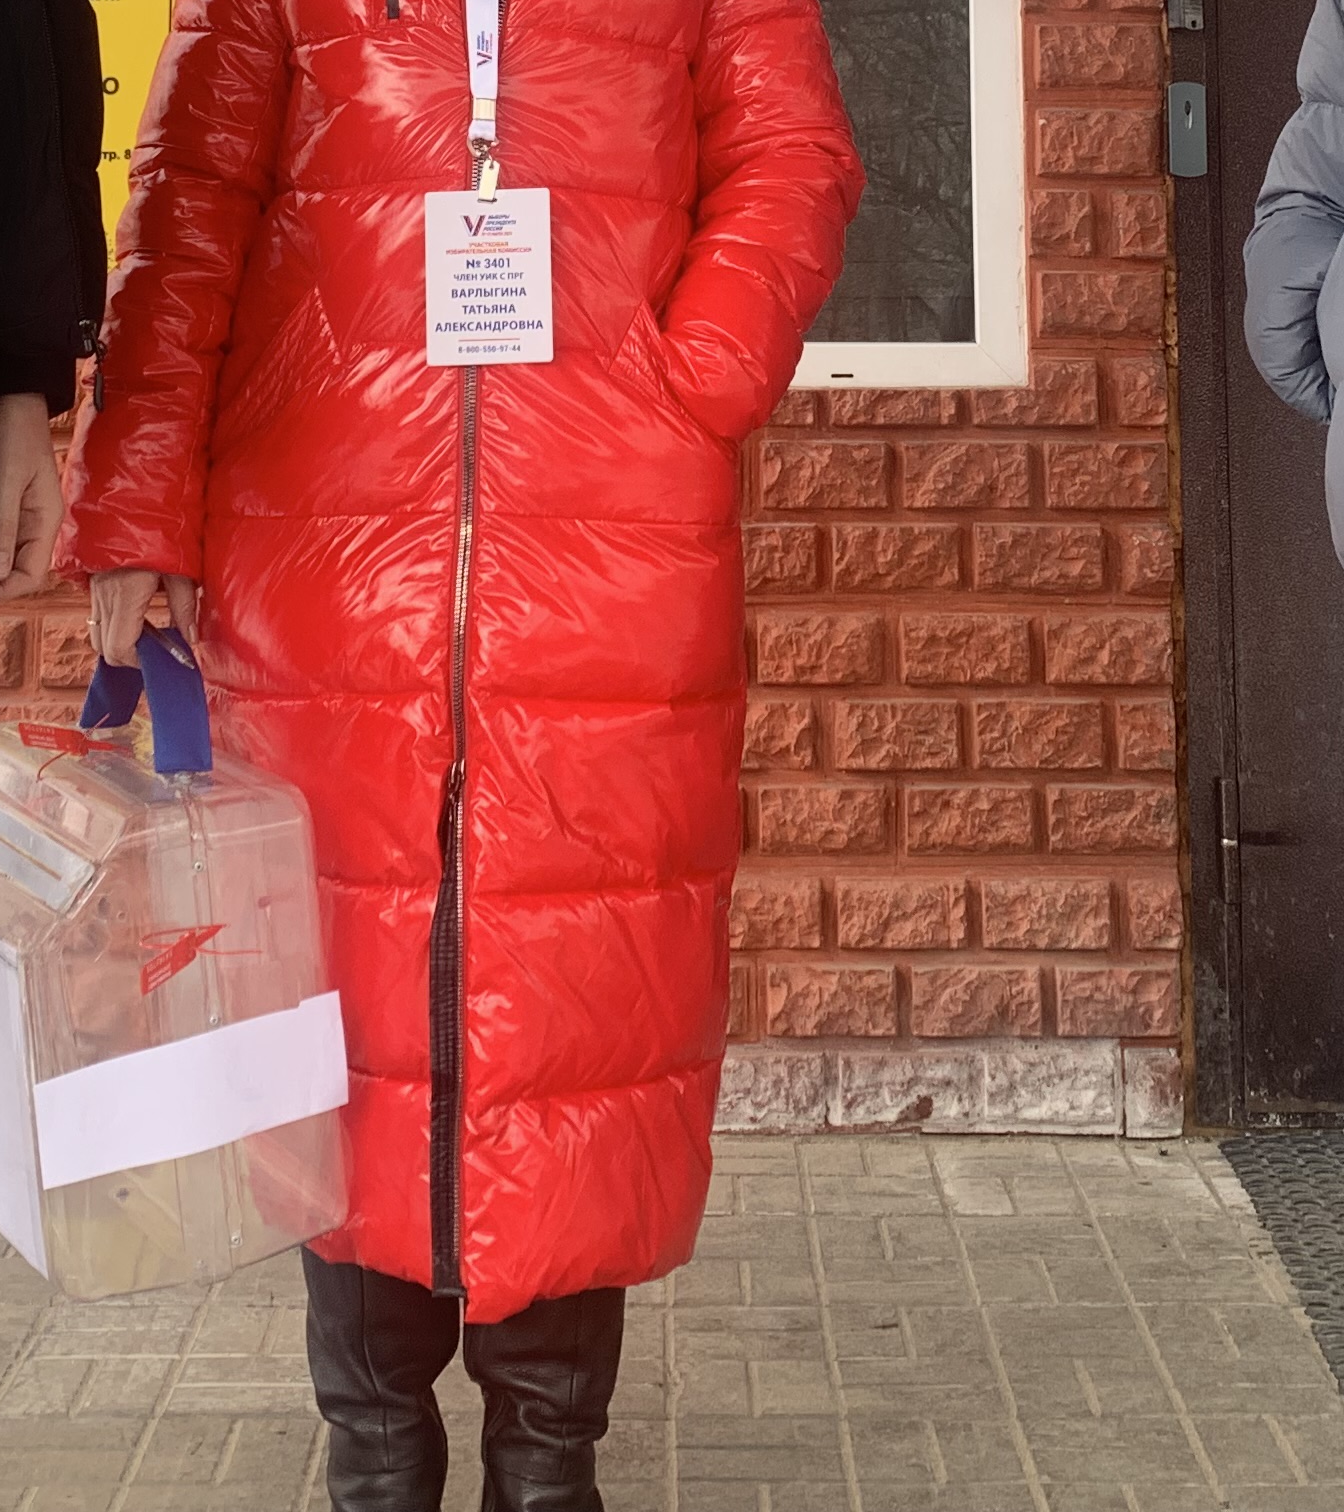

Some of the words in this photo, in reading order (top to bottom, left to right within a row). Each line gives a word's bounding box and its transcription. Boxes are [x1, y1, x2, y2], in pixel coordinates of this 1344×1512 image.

[484, 258, 510, 269] 3401
[453, 273, 478, 281] ЧЛЕН
[480, 273, 498, 281] УИК
[500, 272, 506, 280] С
[507, 272, 524, 280] ПРГ
[451, 287, 527, 298] ВАРЛЫГИНА
[462, 304, 516, 315] ТАТЬЯНА
[435, 320, 543, 332] АЛЕКСАНДРОВНА
